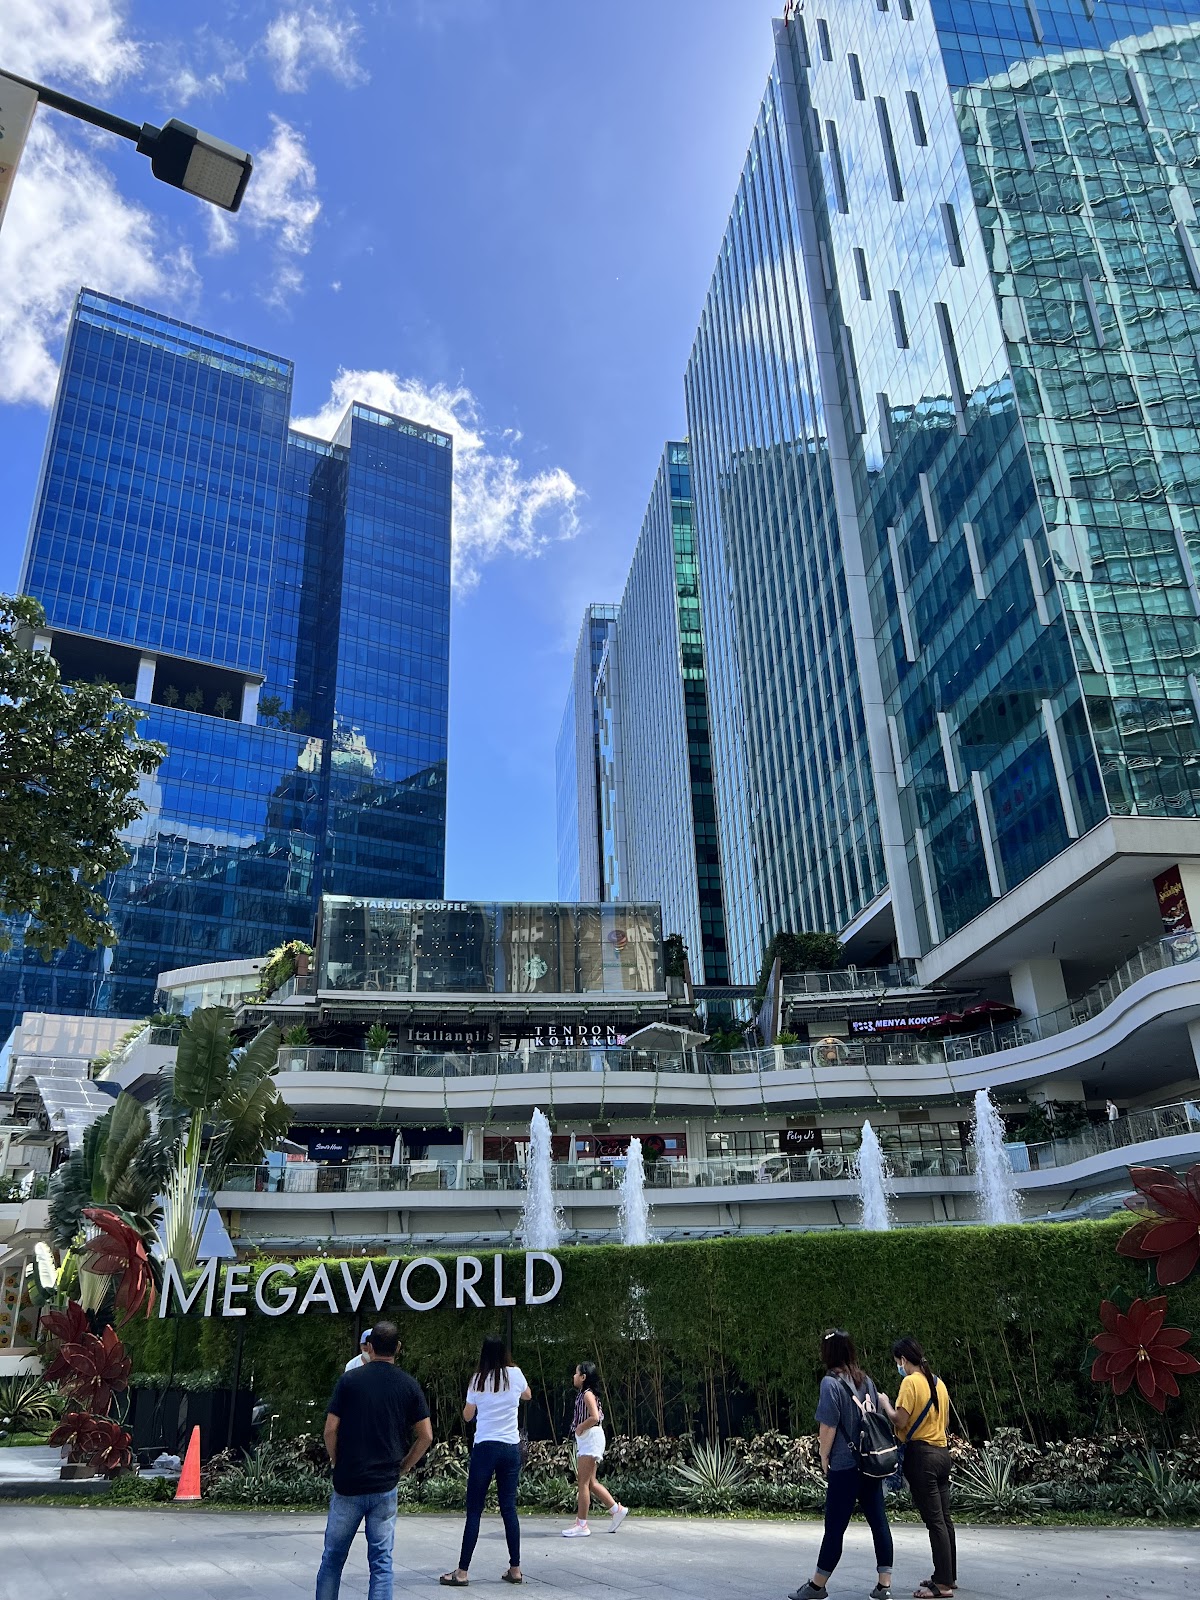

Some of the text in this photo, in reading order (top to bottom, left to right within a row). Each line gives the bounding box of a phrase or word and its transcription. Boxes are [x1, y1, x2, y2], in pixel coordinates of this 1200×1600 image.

[355, 900, 468, 911] STARBUCKS COFFEE
[875, 1019, 906, 1028] MENYA
[535, 1026, 615, 1036] TENDON
[535, 1036, 615, 1046] KOHAKU
[158, 1251, 563, 1318] MEGAWORLD
